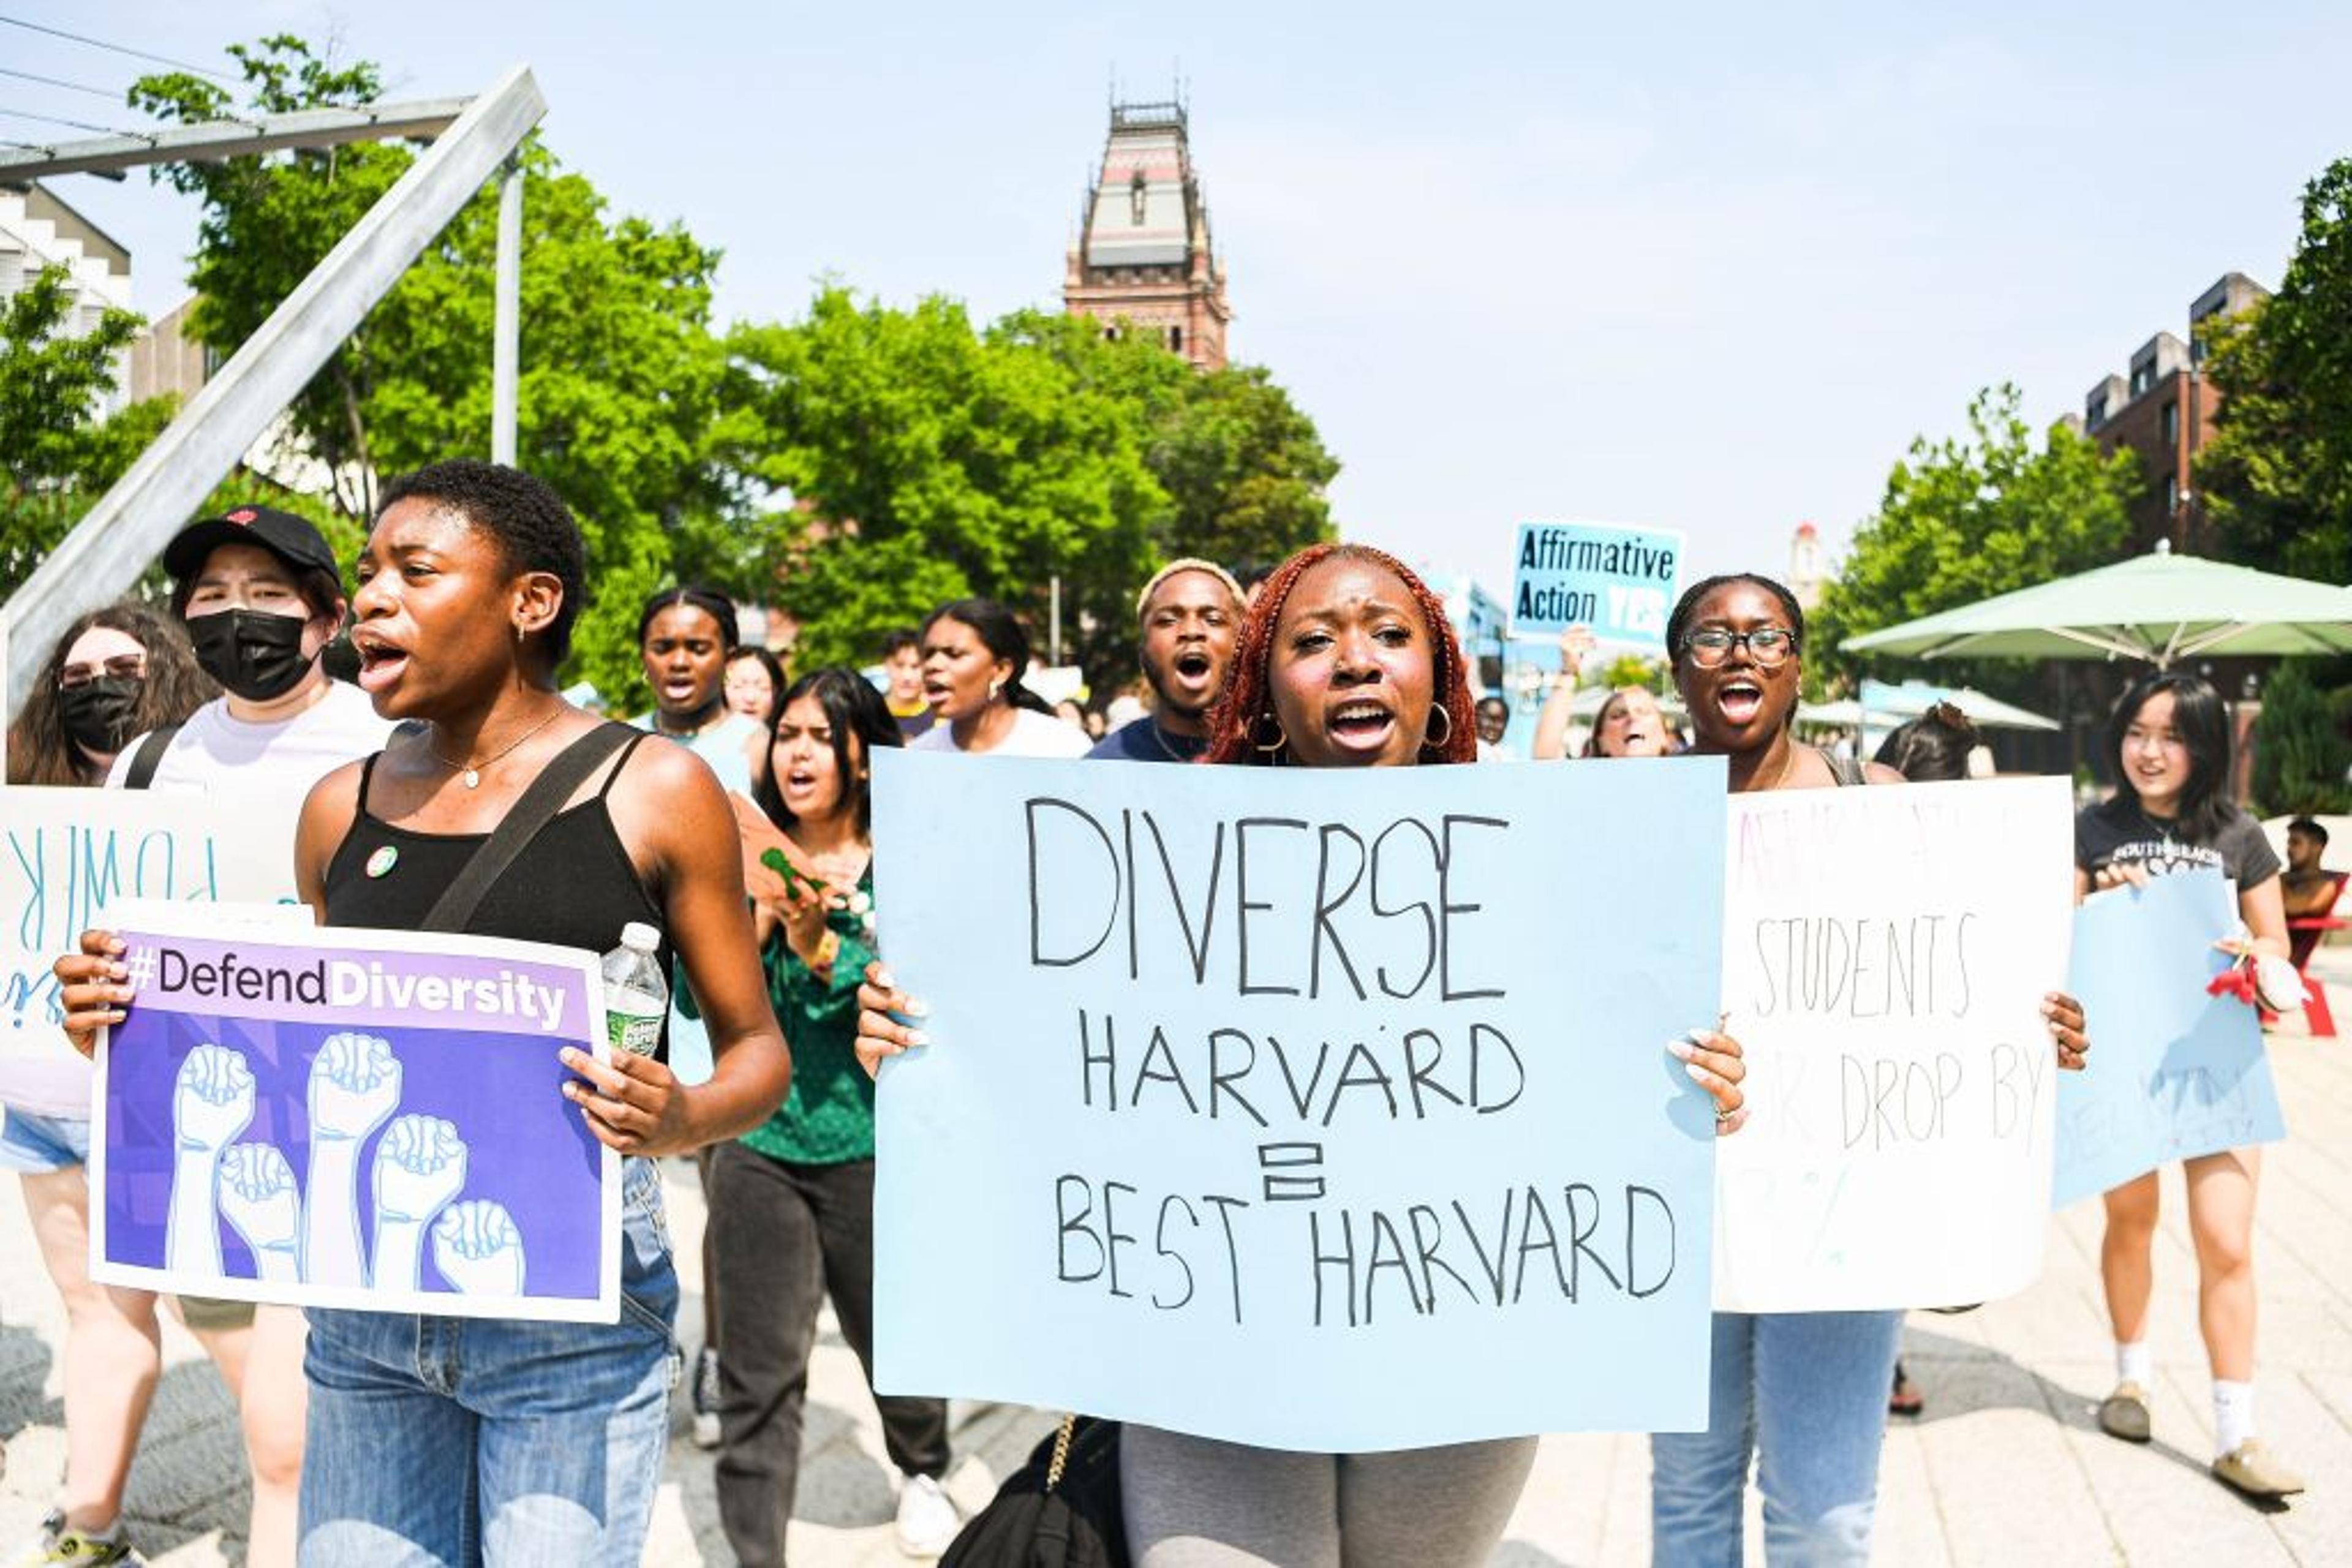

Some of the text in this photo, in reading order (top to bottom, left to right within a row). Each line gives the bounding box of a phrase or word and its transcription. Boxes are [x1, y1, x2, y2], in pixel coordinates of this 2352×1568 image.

[1517, 580, 1596, 623] Action
[1520, 529, 1673, 581] Affirmative
[1025, 797, 1510, 1002] DIVERSE
[127, 945, 565, 1031] #DefendDiversity
[1754, 912, 1978, 1019] STUDENTS
[1079, 1008, 1525, 1127] HARVARD
[1840, 1052, 1964, 1153] DROP
[1990, 1042, 2046, 1158] BY
[1055, 1174, 1675, 1327] BEST HARVARD
